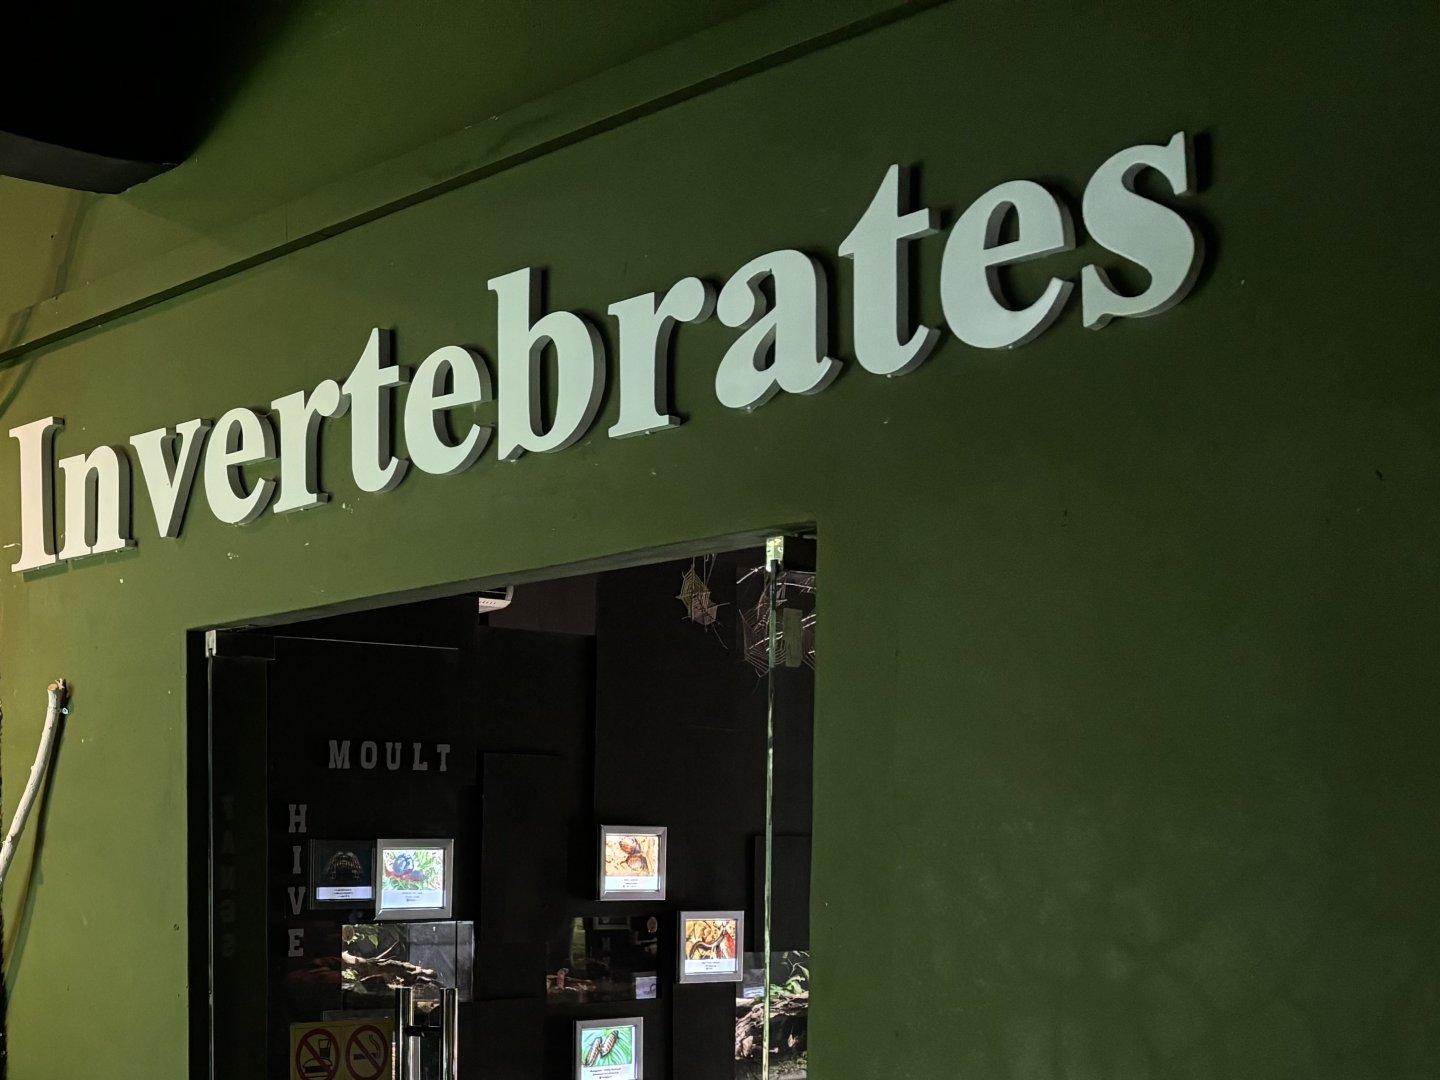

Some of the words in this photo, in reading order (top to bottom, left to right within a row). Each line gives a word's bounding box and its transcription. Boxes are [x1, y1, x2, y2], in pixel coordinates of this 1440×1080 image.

[8, 131, 1205, 577] Invertebrates
[328, 739, 451, 772] MOULT
[287, 803, 308, 958] HIVE
